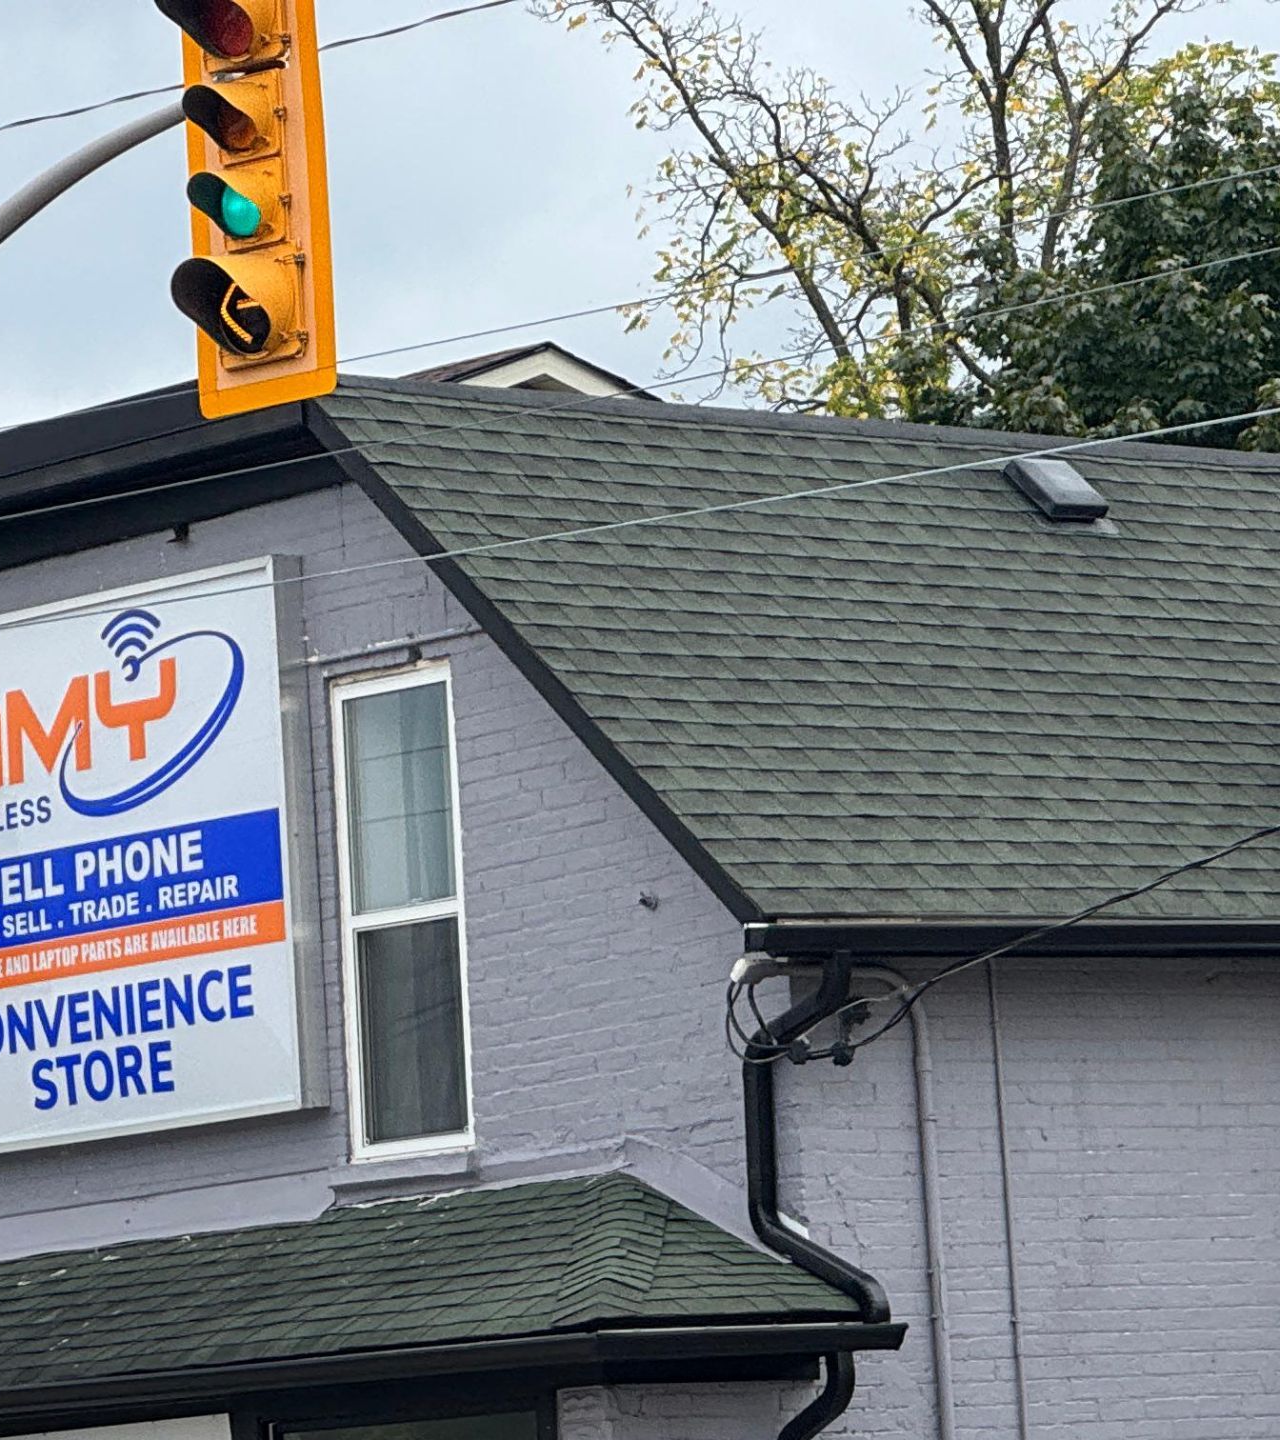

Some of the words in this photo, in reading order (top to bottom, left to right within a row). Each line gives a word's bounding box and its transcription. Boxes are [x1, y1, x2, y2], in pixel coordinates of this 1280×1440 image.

[75, 830, 204, 892] PHONE
[2, 907, 53, 939] SELL
[69, 893, 140, 927] TRADE
[159, 875, 238, 909] REPAIR
[6, 955, 30, 977] AND
[32, 947, 78, 971] LAPTOP
[82, 942, 121, 964] PARTS
[124, 936, 148, 955] ARE
[151, 924, 220, 952] AVAILABLE
[223, 914, 257, 937] HERE
[32, 1040, 175, 1110] STORE
